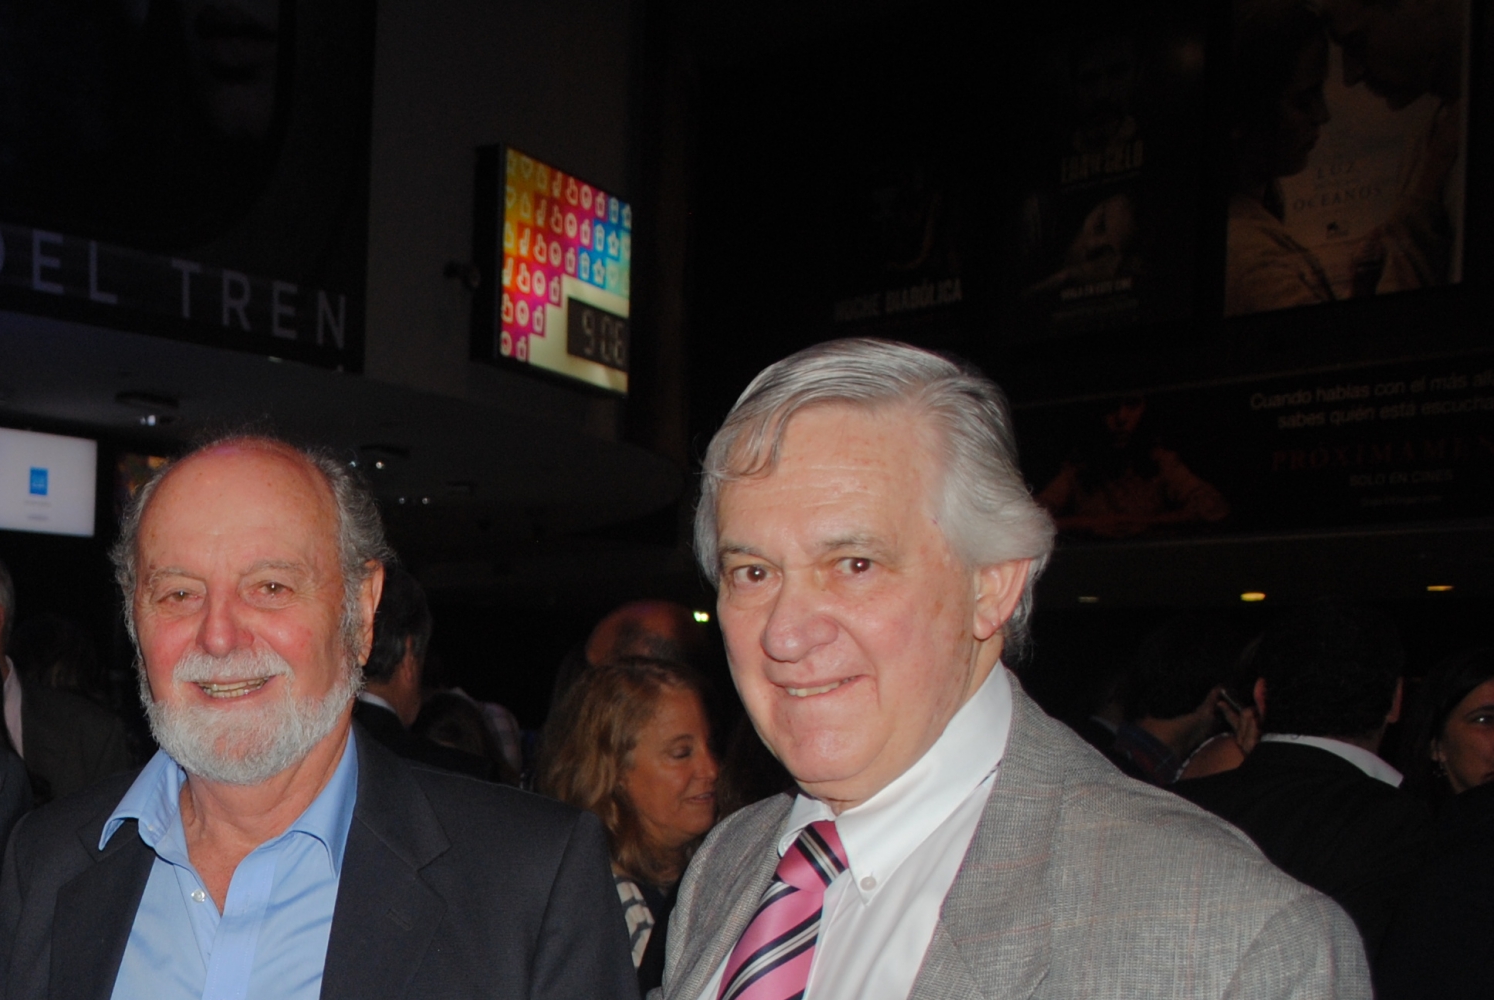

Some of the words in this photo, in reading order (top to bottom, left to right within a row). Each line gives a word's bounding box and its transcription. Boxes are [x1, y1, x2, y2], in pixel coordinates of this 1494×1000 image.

[171, 257, 346, 350] TREN
[1250, 389, 1312, 411] Cuando
[1315, 384, 1371, 404] hablas
[1374, 381, 1405, 396] con
[1409, 376, 1426, 394] el
[1429, 372, 1467, 391] más
[1277, 410, 1326, 431] sabes
[1329, 405, 1376, 427] quién
[1379, 401, 1416, 420] está
